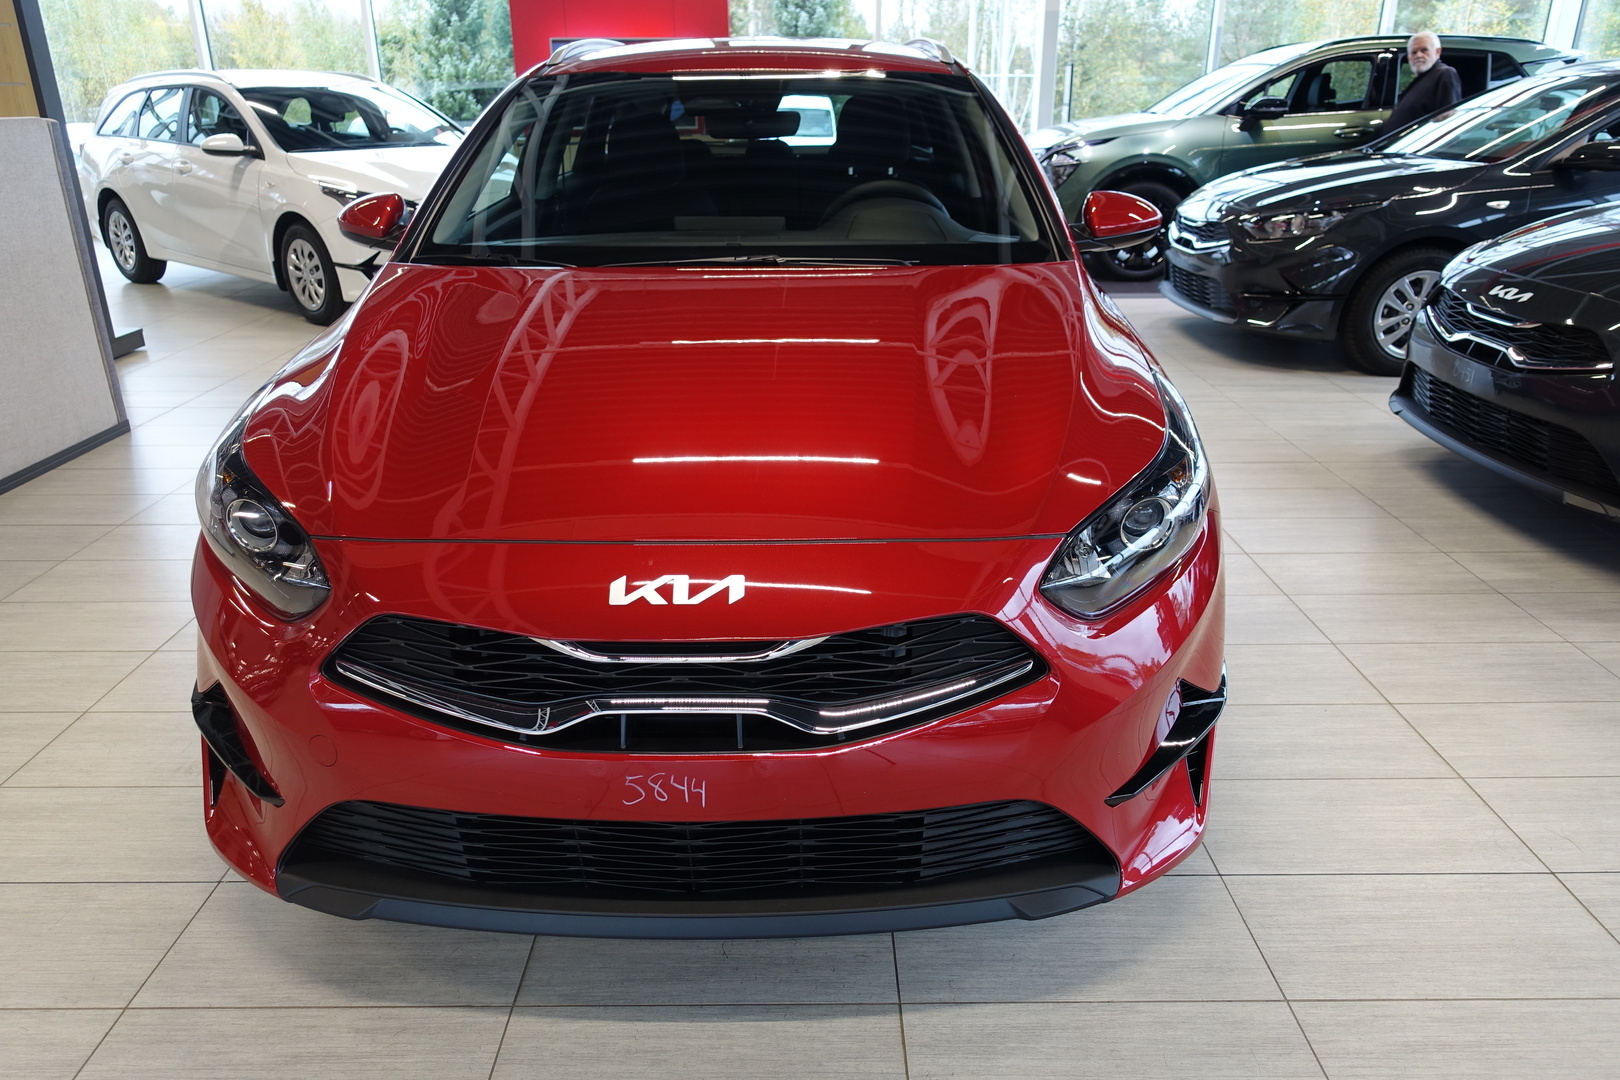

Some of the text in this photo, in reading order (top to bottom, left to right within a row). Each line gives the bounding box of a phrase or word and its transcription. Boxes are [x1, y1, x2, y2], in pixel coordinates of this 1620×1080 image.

[1488, 284, 1534, 303] KIA
[608, 574, 746, 606] KIA
[622, 772, 706, 808] 5844
